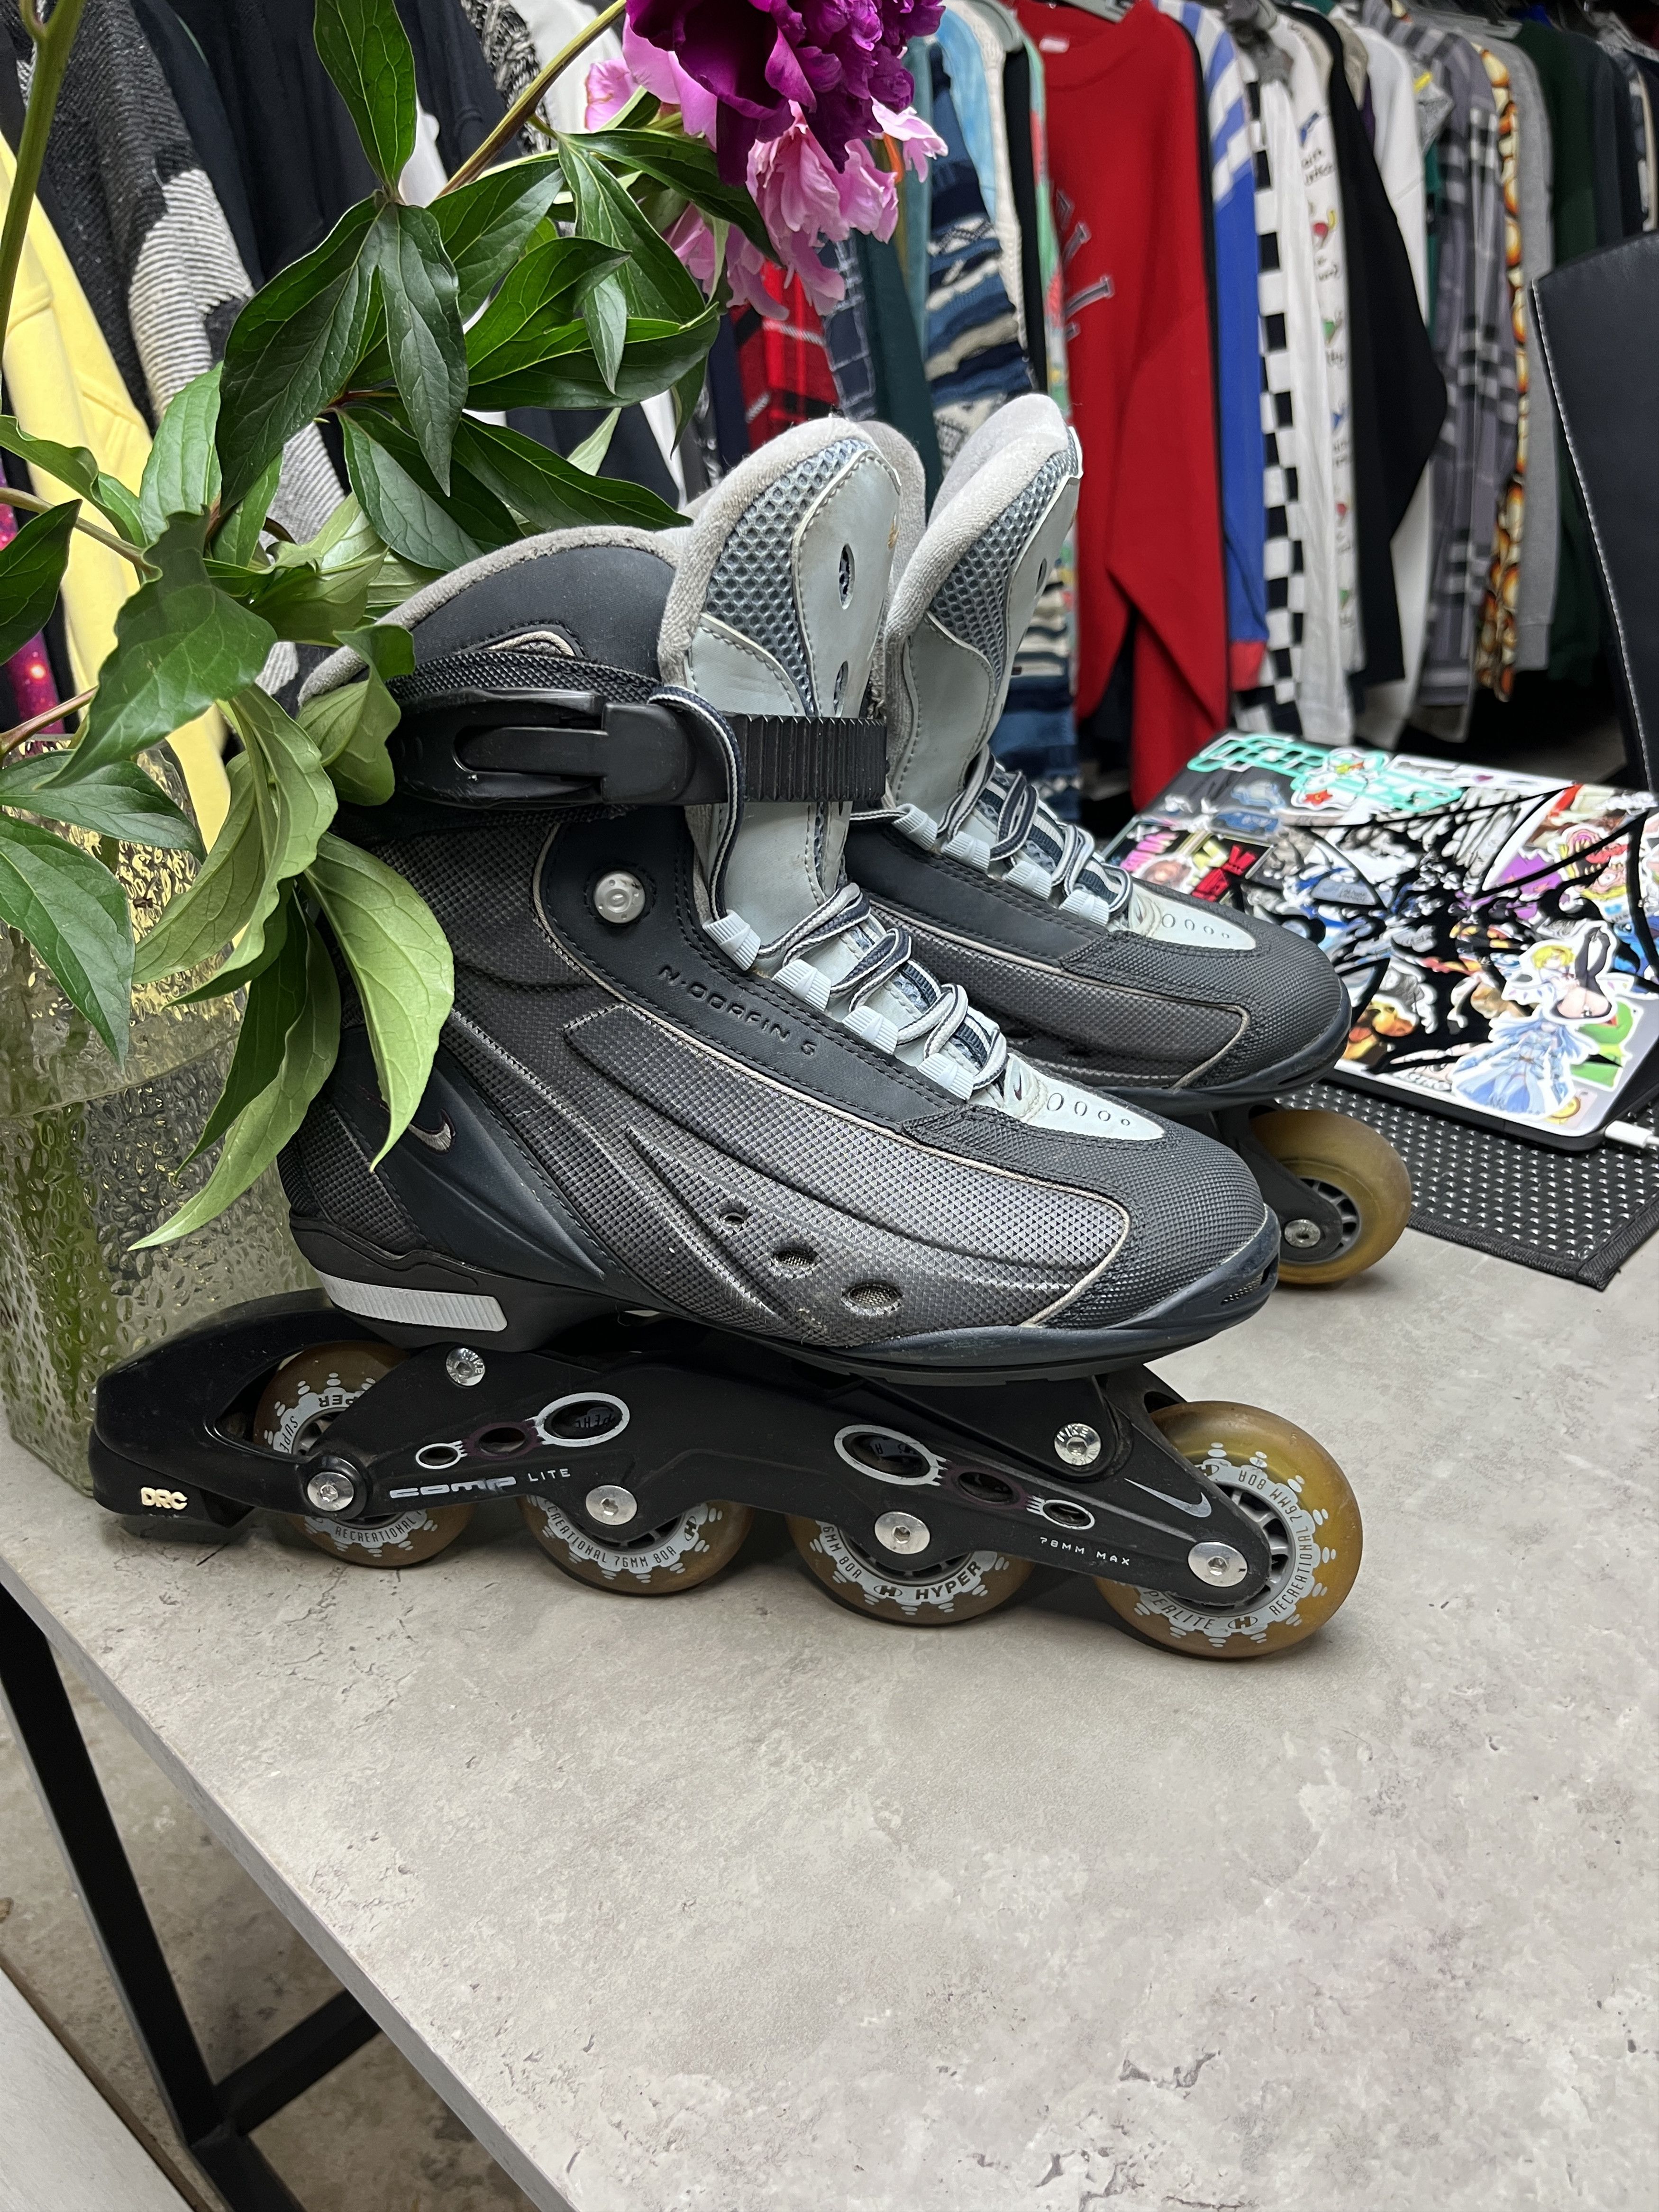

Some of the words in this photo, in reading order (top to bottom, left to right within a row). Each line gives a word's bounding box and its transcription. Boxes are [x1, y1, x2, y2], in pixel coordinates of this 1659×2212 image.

[318, 1394, 358, 1408] PER
[528, 1468, 571, 1482] LITE
[140, 1487, 188, 1510] DRC
[1268, 1487, 1303, 1523] 76MM
[335, 1517, 417, 1542] RECREATIONAL
[546, 1503, 607, 1563] CREATIONAL
[614, 1555, 649, 1568] 76MM
[823, 1526, 842, 1552] 6MM
[915, 1560, 981, 1600] HYPER
[1040, 1537, 1085, 1555] 78MM
[1096, 1551, 1130, 1566] MAX
[1268, 1526, 1313, 1616] RECREATIONAL
[1143, 1590, 1215, 1629] PERLITE
